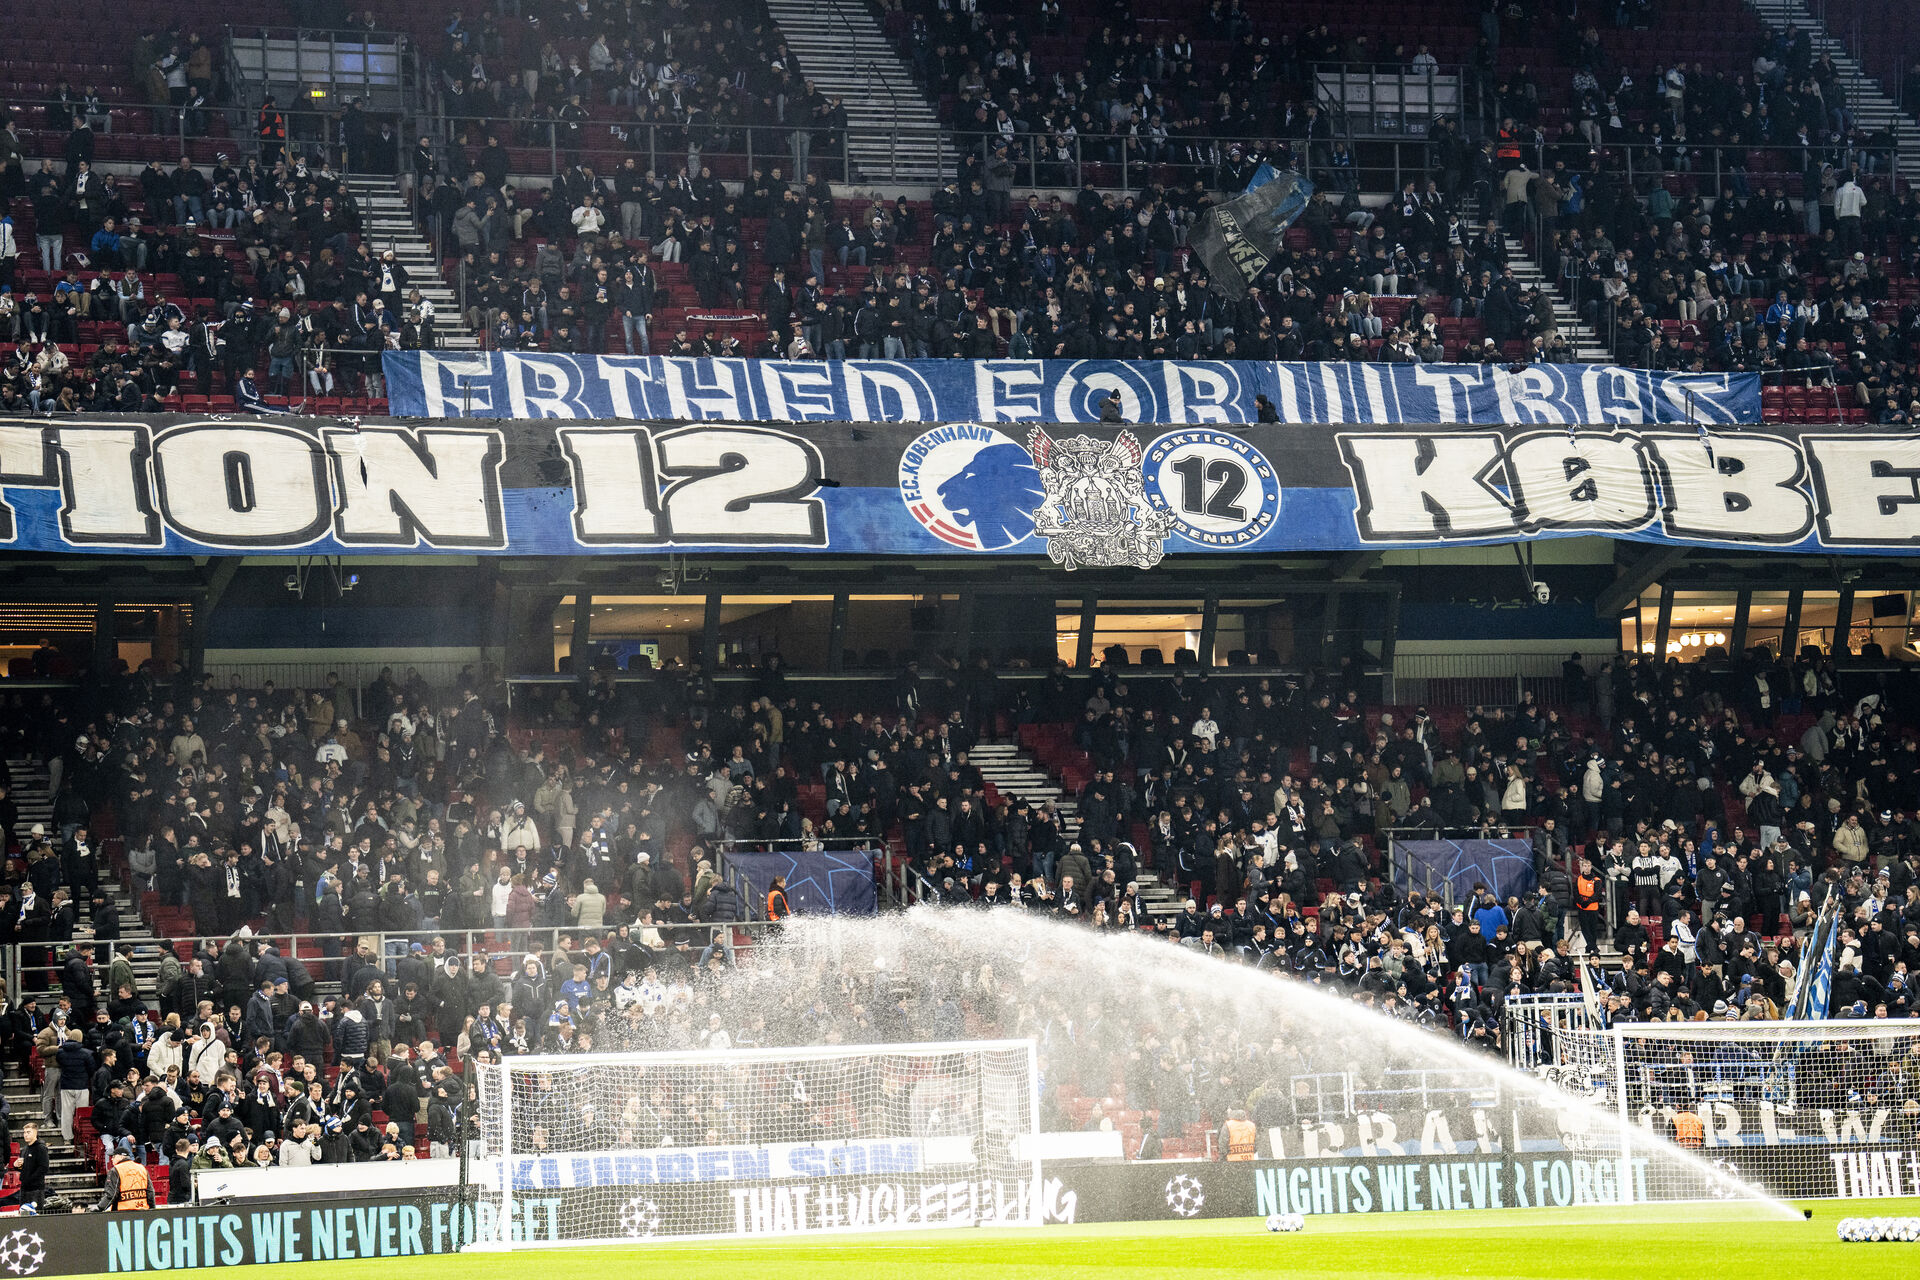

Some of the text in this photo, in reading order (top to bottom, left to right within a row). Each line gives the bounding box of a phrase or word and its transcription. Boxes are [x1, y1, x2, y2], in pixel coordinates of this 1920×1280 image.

[1411, 124, 1425, 133] B5
[1151, 433, 1272, 479] SEKTION 12
[556, 424, 829, 549] 12
[1171, 455, 1249, 522] 12
[1151, 493, 1272, 544] KBENHAVN
[120, 1190, 148, 1201] STEWAR
[1255, 1157, 1649, 1217] NIGHTS WE NEVER FORGET
[1830, 1151, 1903, 1199] THAT
[107, 1214, 244, 1272] NIGHTS
[251, 1211, 303, 1264] WE
[311, 1205, 425, 1260] NEVER
